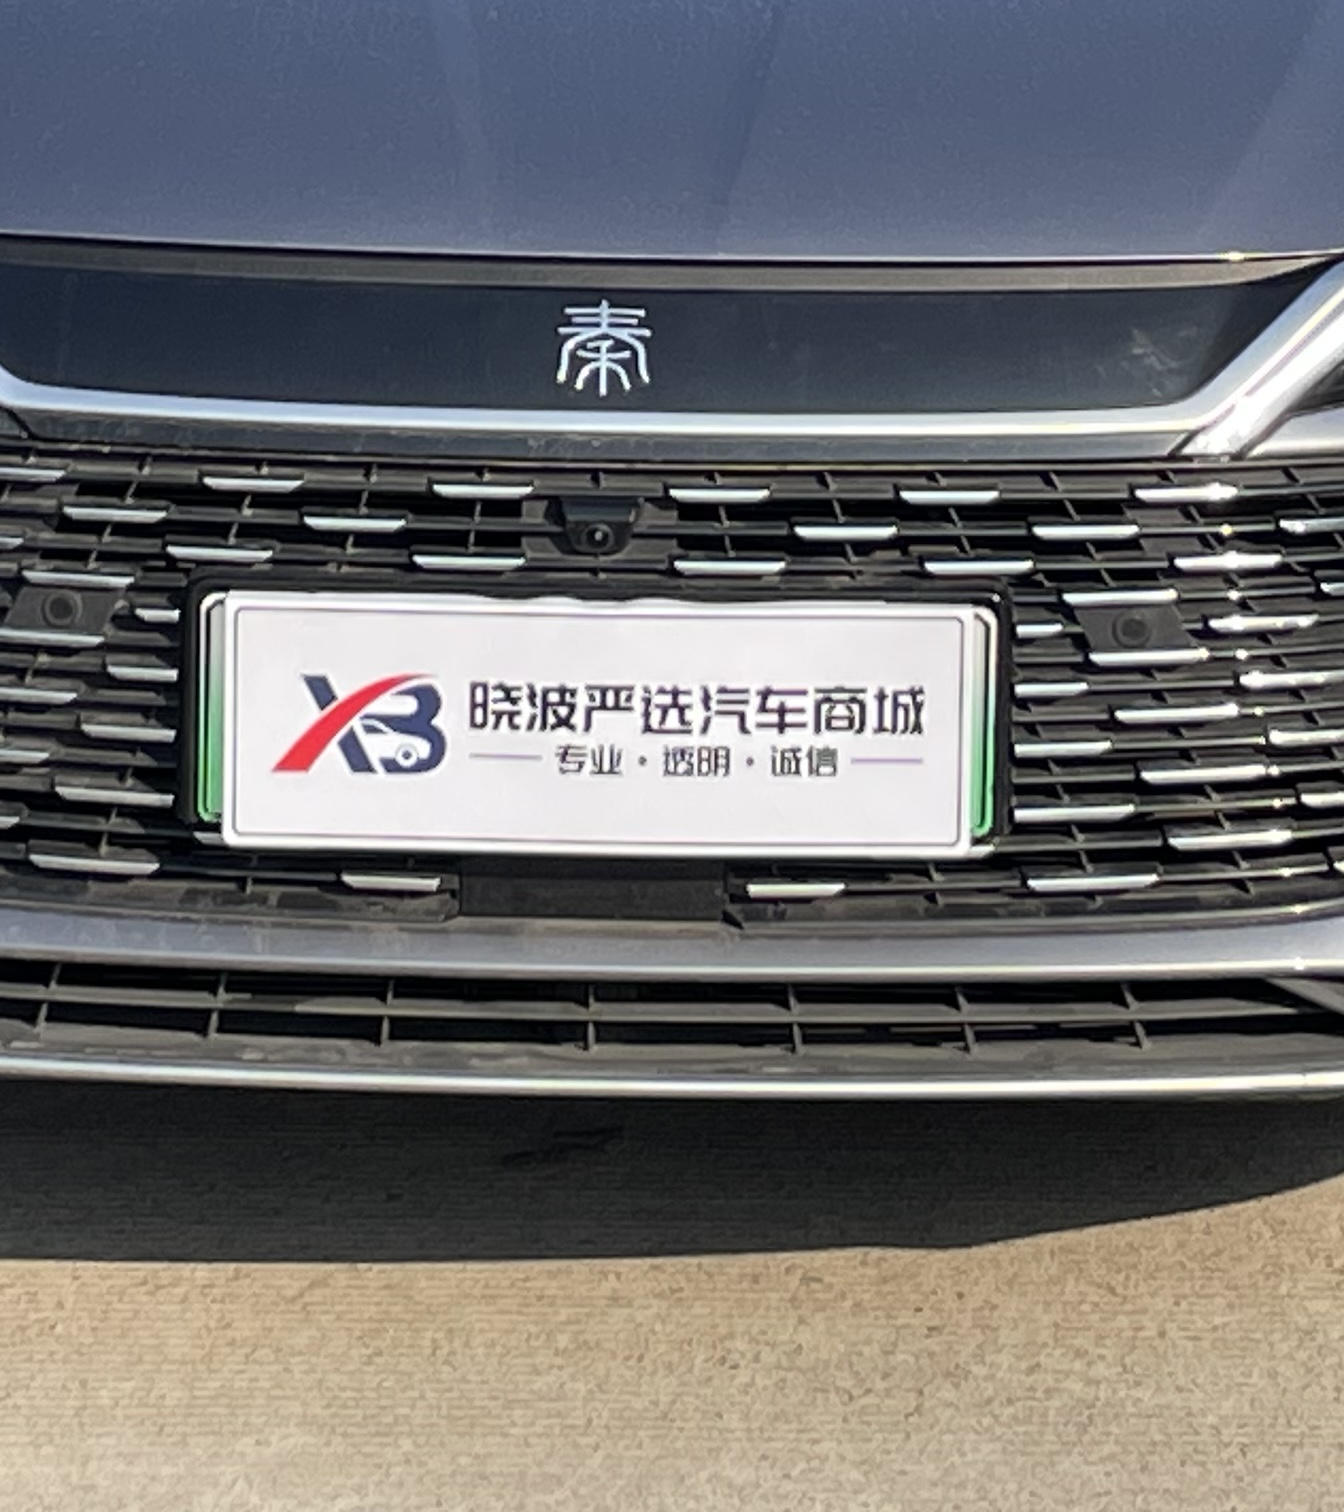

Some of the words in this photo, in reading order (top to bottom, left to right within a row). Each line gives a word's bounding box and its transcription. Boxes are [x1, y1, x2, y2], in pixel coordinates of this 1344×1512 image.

[468, 681, 926, 736] 晓波严选汽车商城
